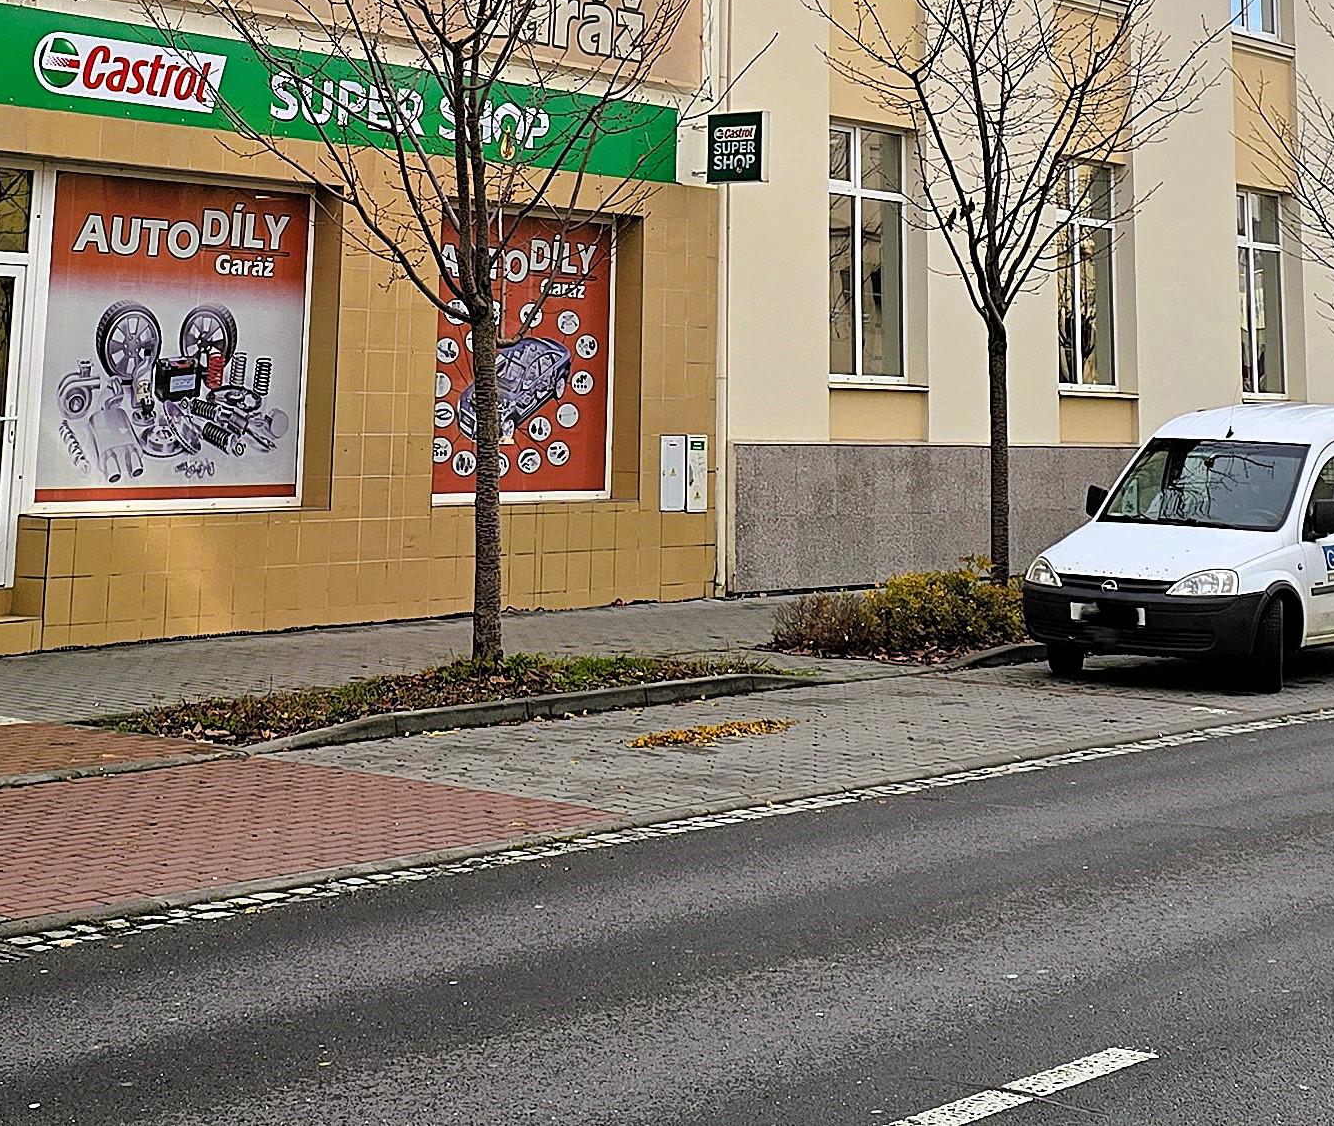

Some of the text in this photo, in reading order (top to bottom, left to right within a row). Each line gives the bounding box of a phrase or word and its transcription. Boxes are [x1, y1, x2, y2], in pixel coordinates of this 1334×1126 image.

[80, 44, 209, 104] Castrol
[269, 70, 426, 139] SUPER
[723, 127, 754, 140] Castrol
[713, 140, 756, 155] SUPER
[713, 154, 756, 171] SHOP
[71, 201, 292, 260] AUTODÍLY
[214, 252, 276, 278] Garáž
[539, 278, 586, 299] Garáž
